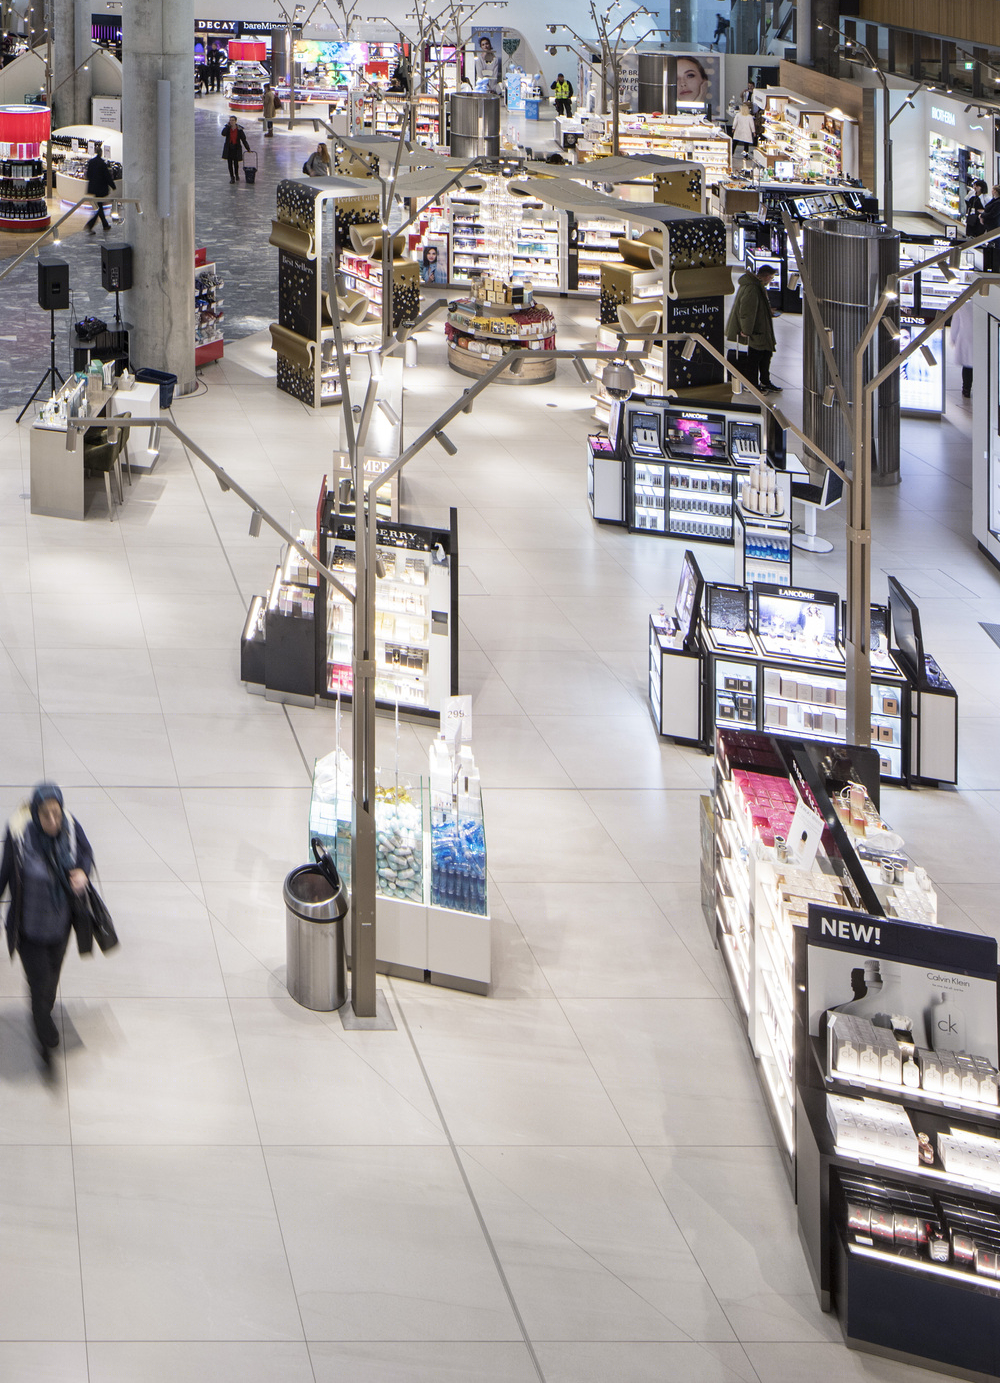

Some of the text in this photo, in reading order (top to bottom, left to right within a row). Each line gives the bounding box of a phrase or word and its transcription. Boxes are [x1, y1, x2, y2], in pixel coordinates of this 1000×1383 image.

[198, 21, 236, 30] DECAY
[282, 255, 314, 274] Best Sellers
[673, 304, 720, 317] Best Sellers
[821, 917, 881, 945] NEW!
[926, 972, 951, 984] Calvin
[951, 976, 971, 988] Klein
[937, 1014, 958, 1035] ck
